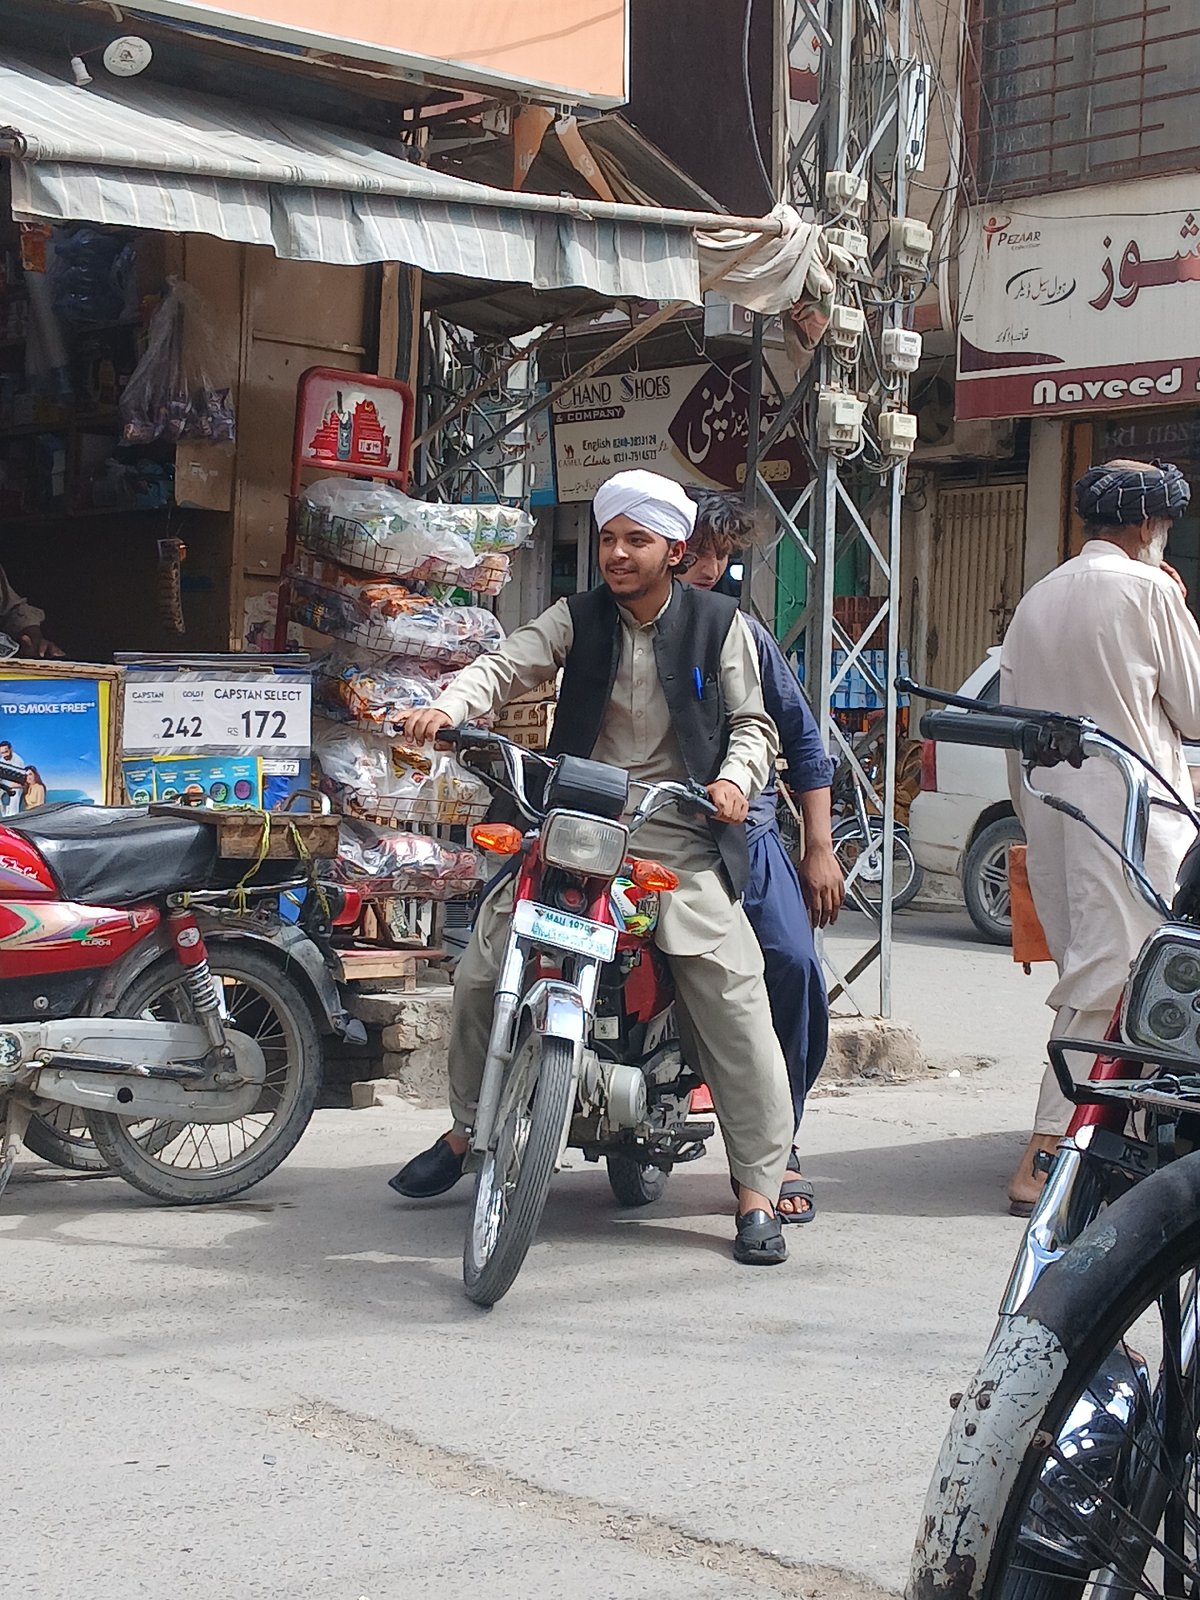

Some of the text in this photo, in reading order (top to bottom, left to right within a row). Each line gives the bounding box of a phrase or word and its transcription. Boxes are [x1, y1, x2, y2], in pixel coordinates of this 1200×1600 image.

[620, 375, 671, 402] SHOES
[567, 408, 622, 421] COMPANY
[582, 437, 611, 452] English
[132, 691, 164, 699] CAPSTAN
[214, 688, 302, 701] CAPSTAN SELECT
[1, 704, 17, 714] TO
[18, 703, 60, 714] SMOKE
[161, 716, 203, 739] 242
[241, 710, 287, 739] 172
